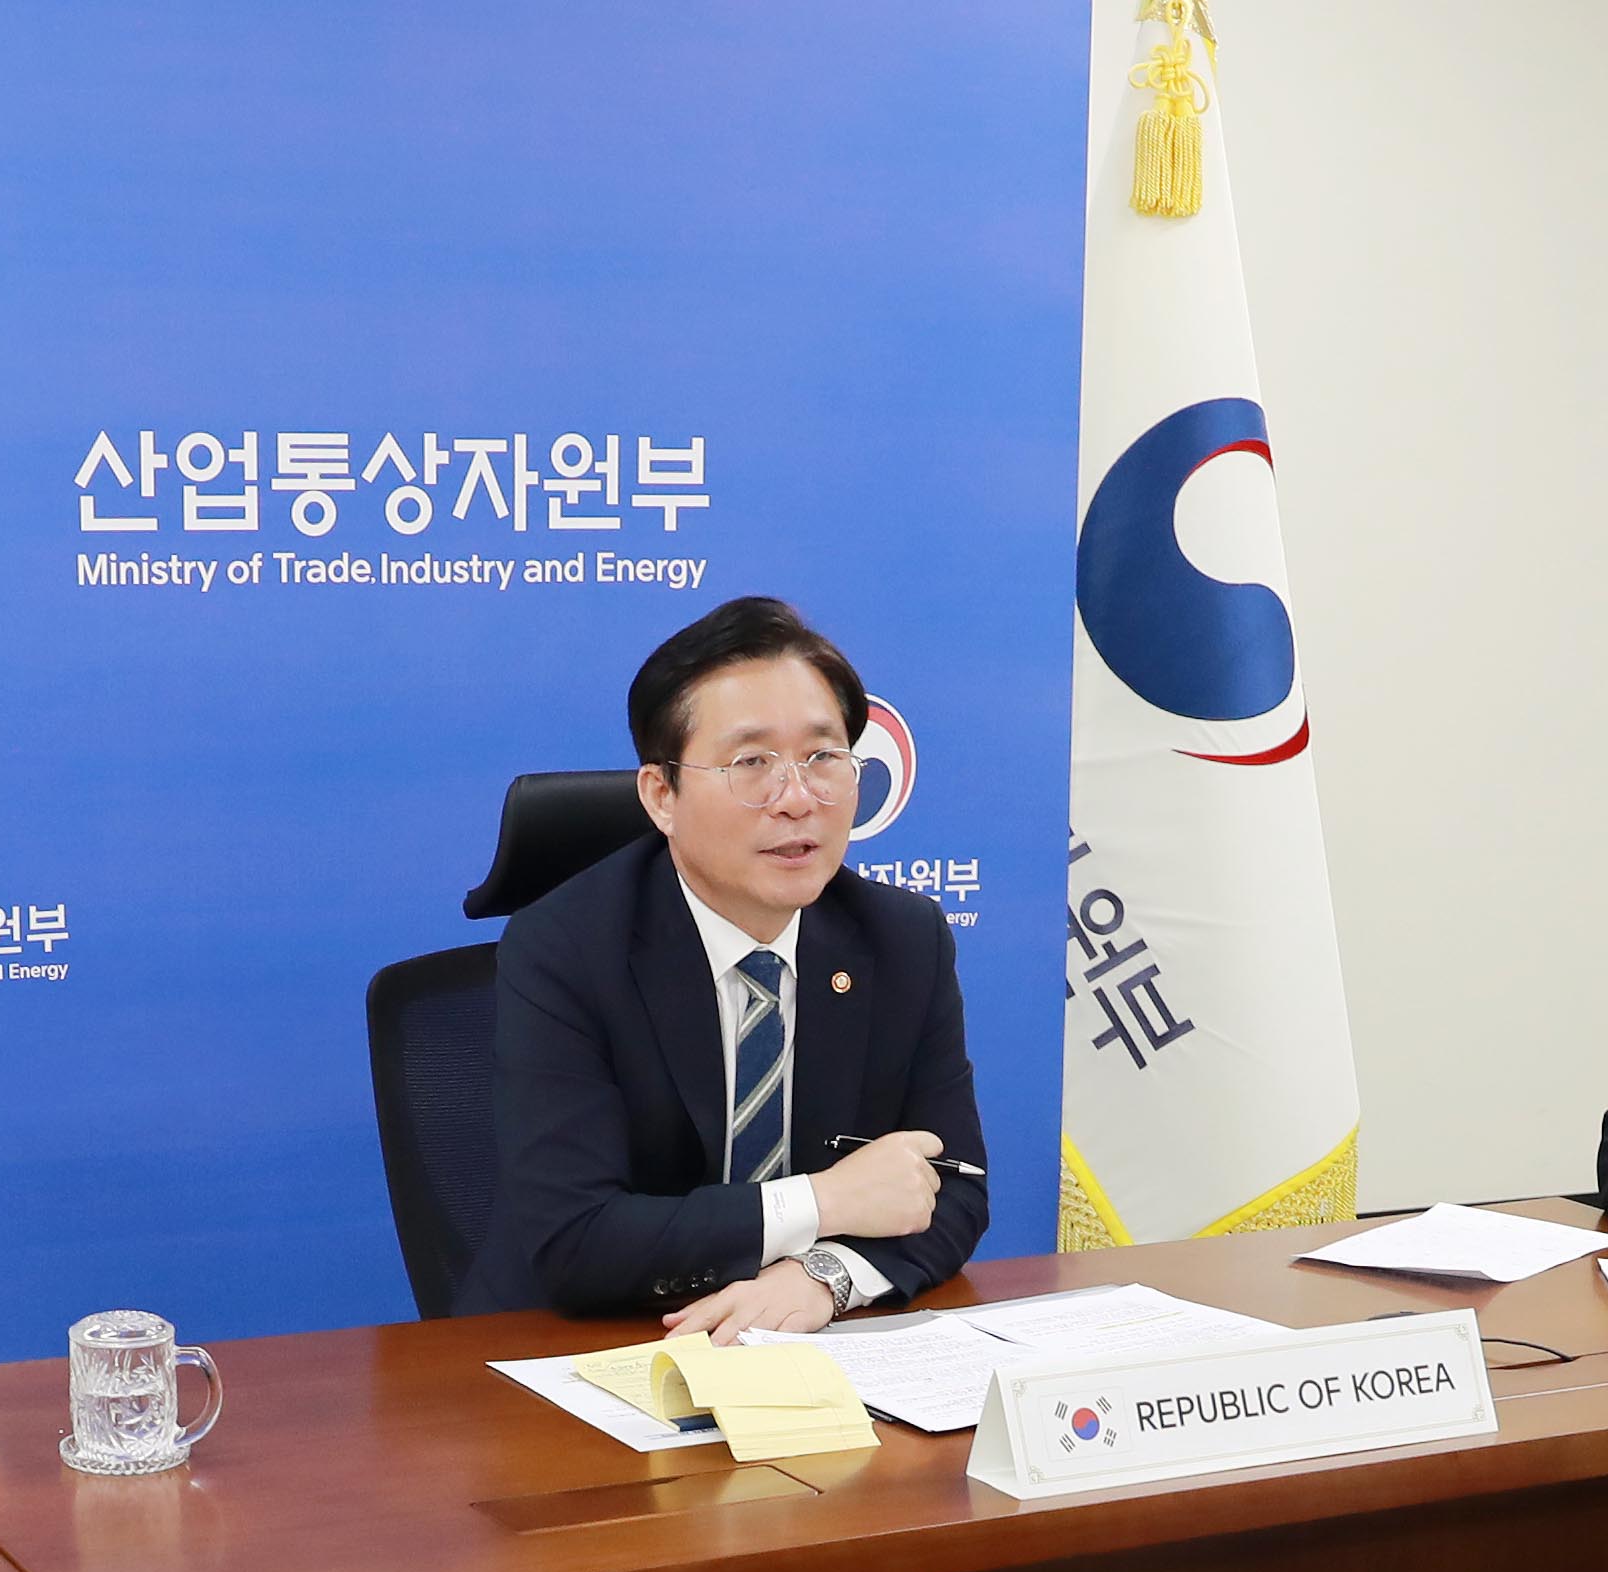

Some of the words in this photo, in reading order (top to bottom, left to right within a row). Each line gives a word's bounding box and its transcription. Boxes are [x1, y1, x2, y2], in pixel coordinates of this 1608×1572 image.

[74, 429, 710, 537] 산업통상자원부
[77, 552, 218, 593] Ministry
[227, 552, 263, 584] of
[523, 552, 584, 584] and
[596, 552, 707, 590] Energy
[945, 911, 979, 927] ergy
[9, 963, 69, 981] Energy
[1135, 1383, 1290, 1432] REPUBLIC
[1298, 1376, 1342, 1410] OF
[1351, 1362, 1457, 1402] KOREA
